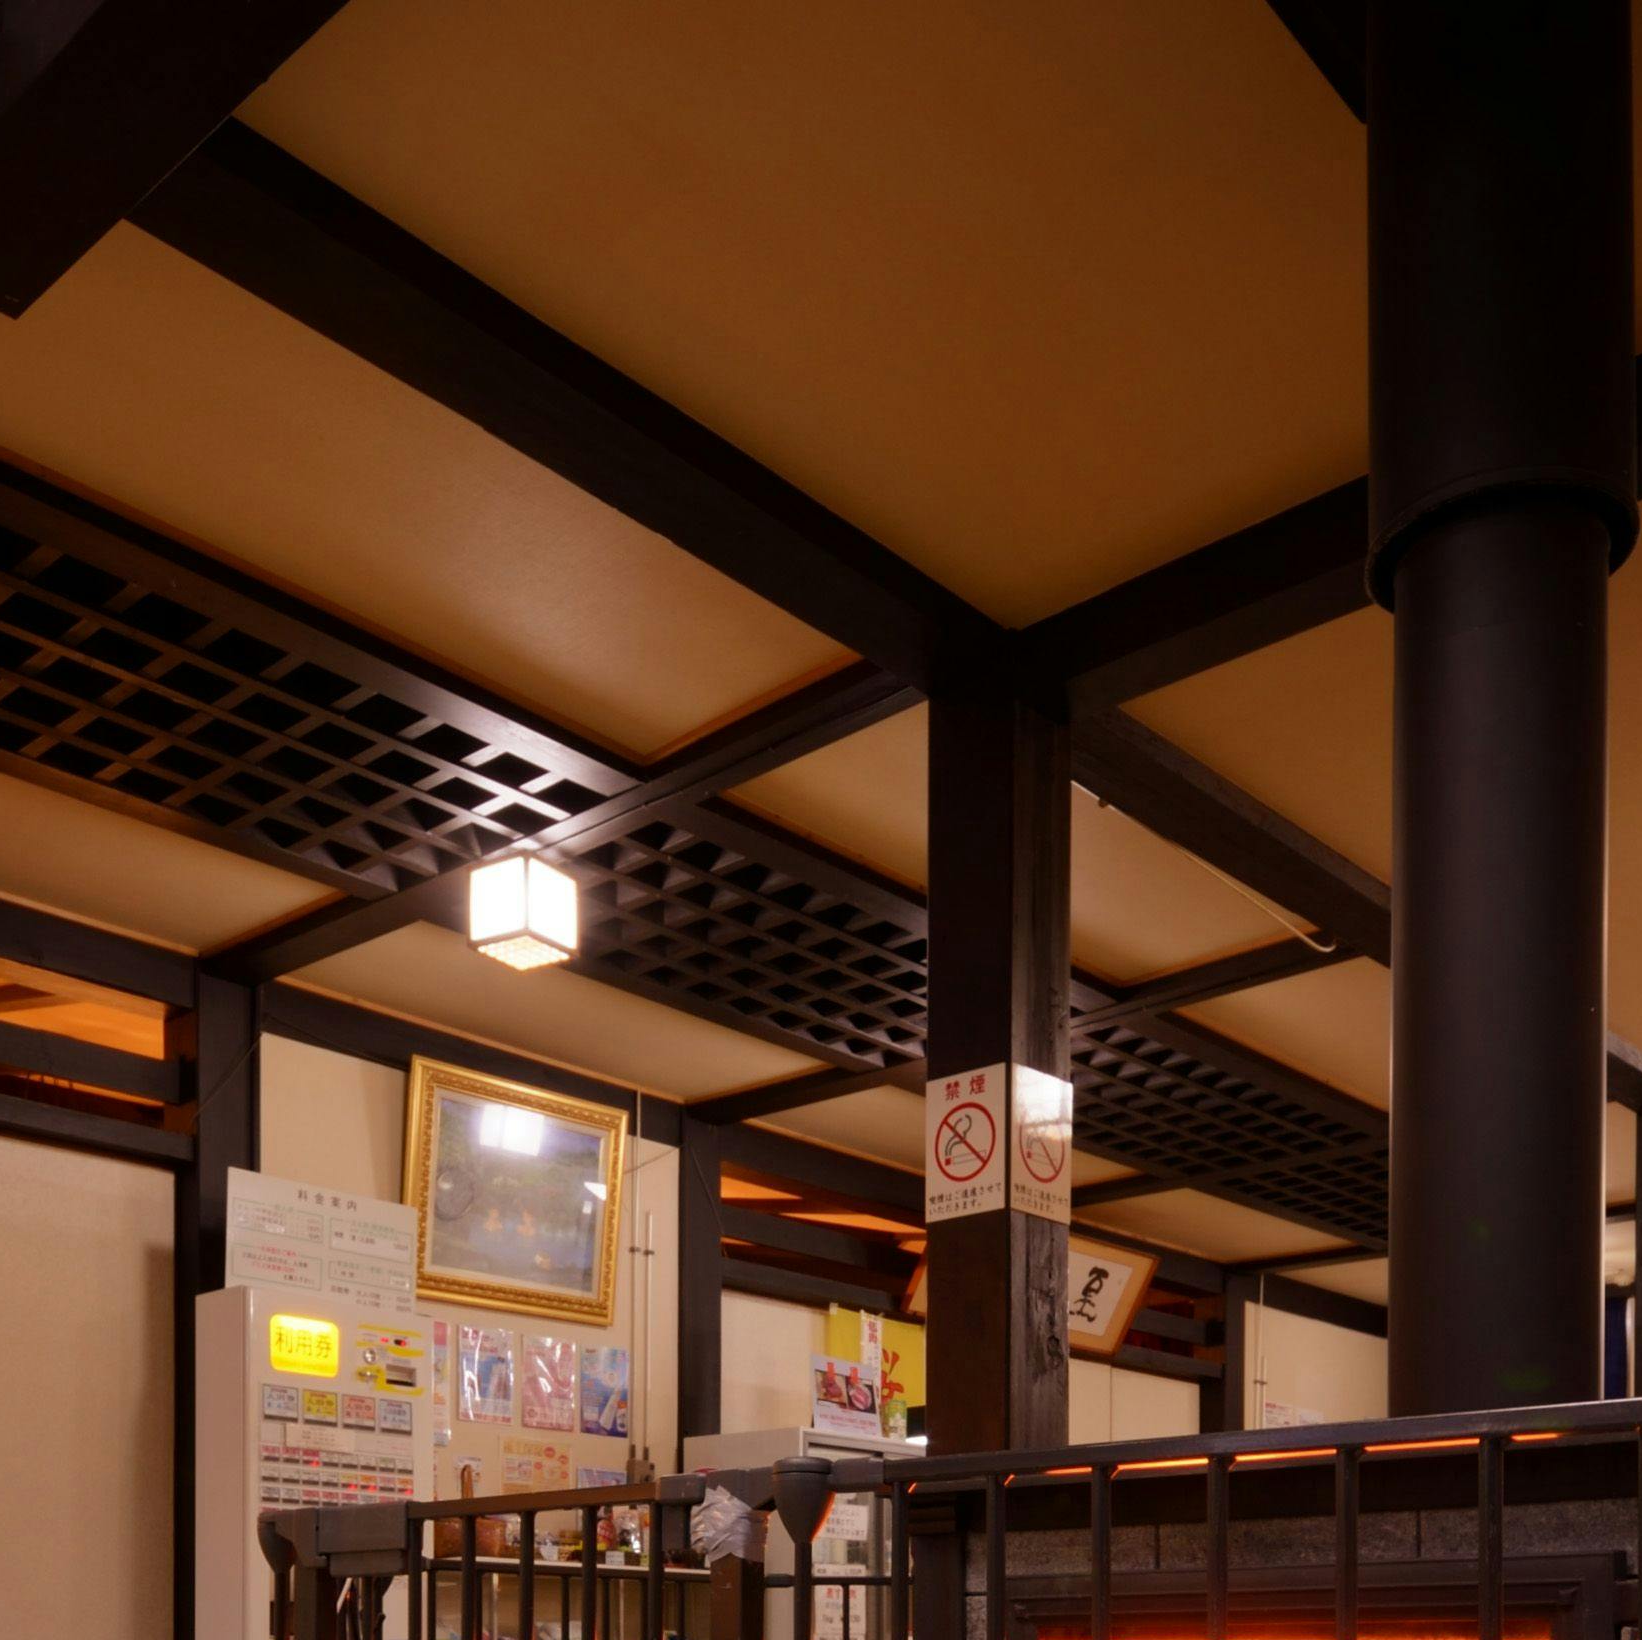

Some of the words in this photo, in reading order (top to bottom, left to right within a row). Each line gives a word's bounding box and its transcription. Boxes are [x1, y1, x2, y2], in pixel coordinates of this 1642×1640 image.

[944, 1074, 986, 1101] 禁煙
[297, 1189, 358, 1211] 料金案内
[275, 1326, 332, 1359] 利用券
